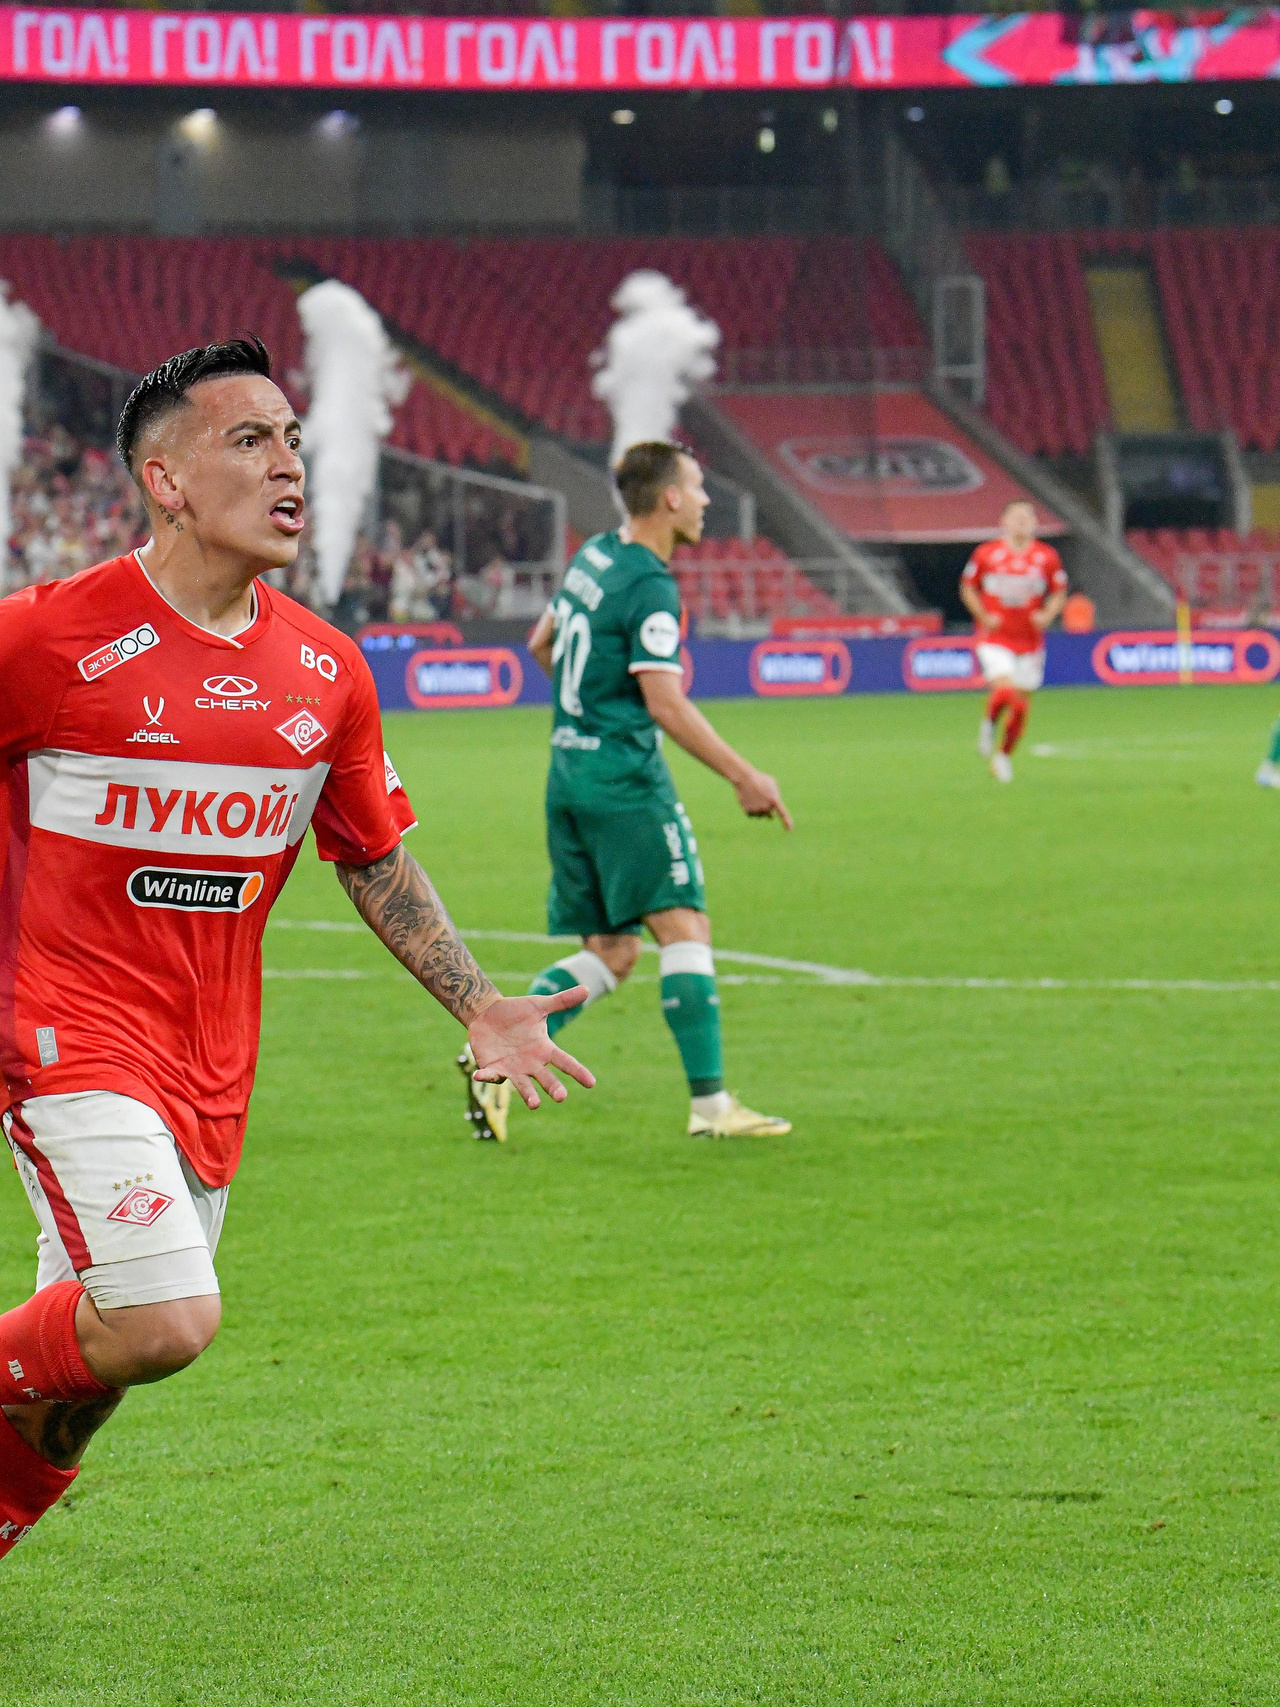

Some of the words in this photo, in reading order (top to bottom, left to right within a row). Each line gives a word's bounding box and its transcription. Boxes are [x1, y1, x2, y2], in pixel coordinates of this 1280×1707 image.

[13, 12, 129, 74] ГОЛ!
[151, 17, 278, 79] ГОЛ!
[300, 19, 423, 82] ГОЛ!
[442, 21, 577, 83] ГОЛ!
[600, 21, 735, 84] ГОЛ!
[758, 21, 894, 84] ГОЛ!
[300, 643, 338, 683] BQ
[194, 697, 272, 711] CHERY
[125, 729, 181, 744] JÖGEL
[143, 875, 234, 903] Winline
